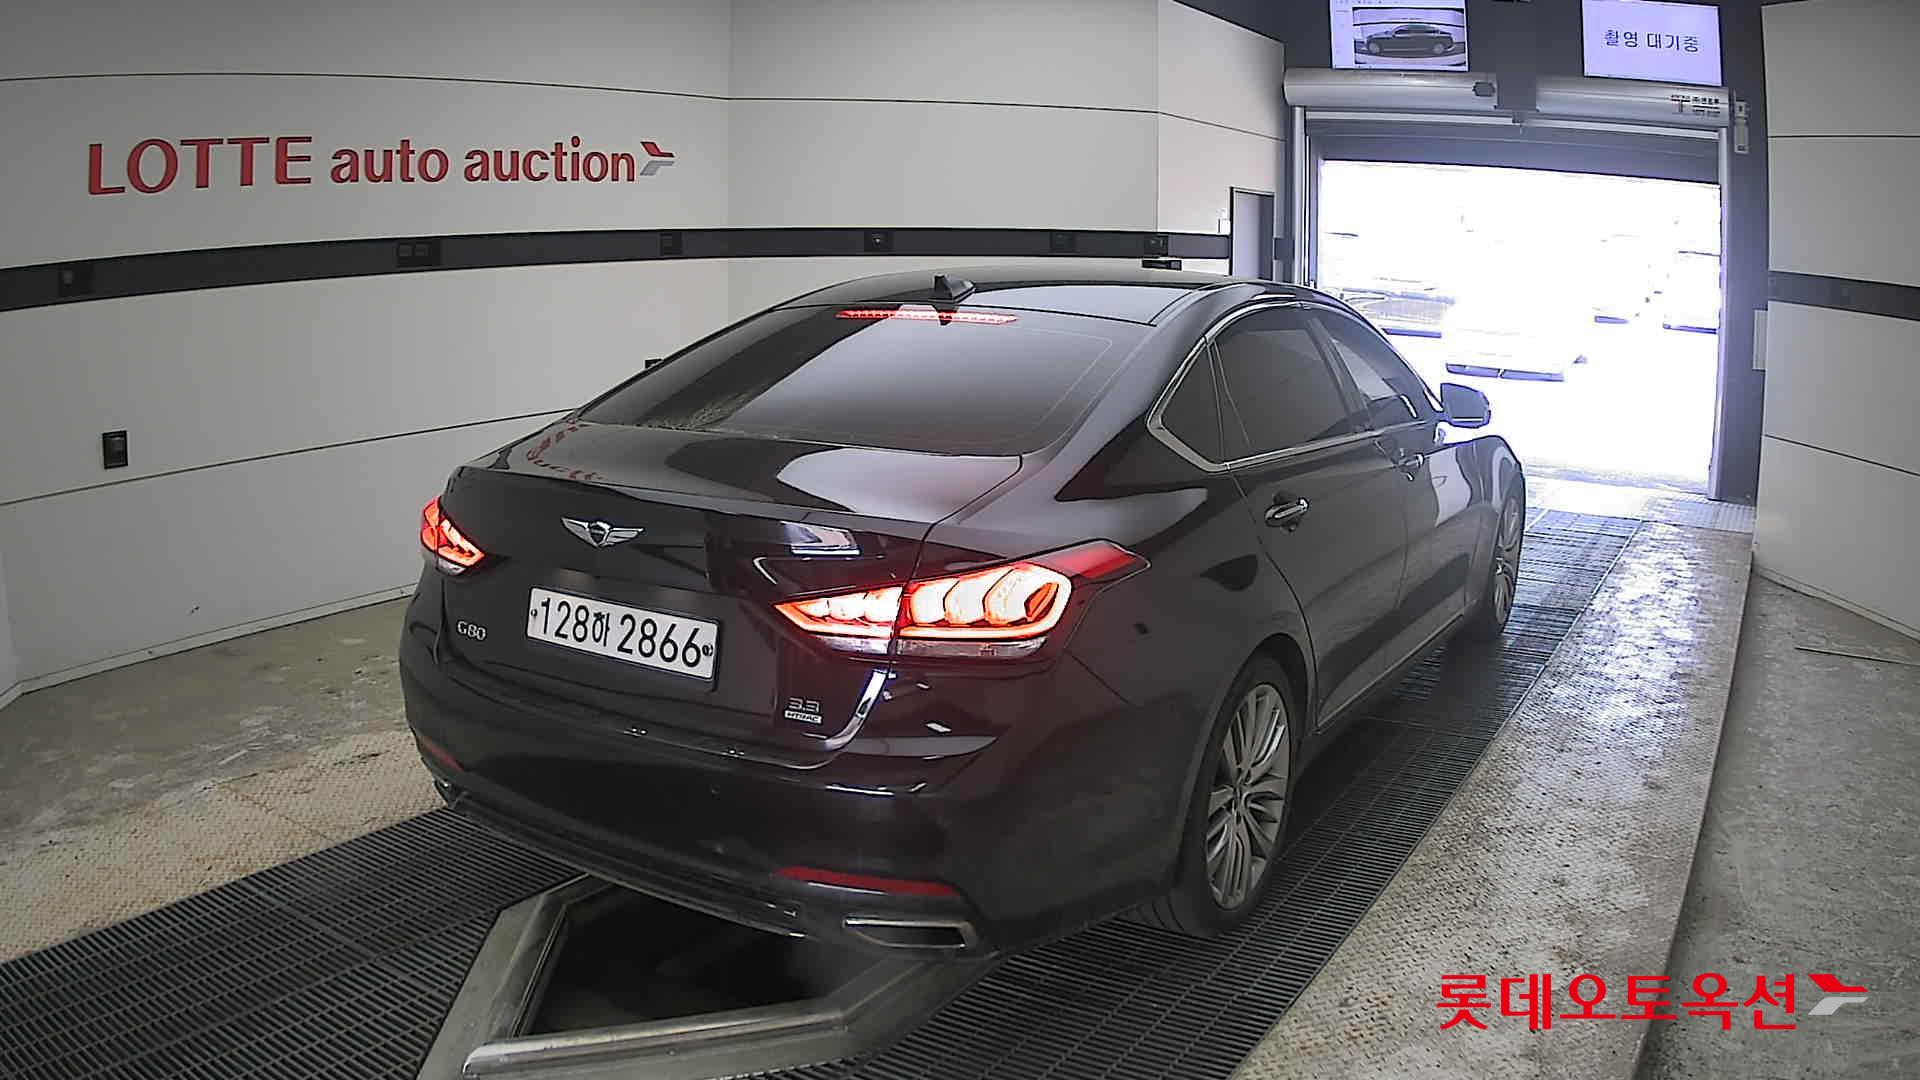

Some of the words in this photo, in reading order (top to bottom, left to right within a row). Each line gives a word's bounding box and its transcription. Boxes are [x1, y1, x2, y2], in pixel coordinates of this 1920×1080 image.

[1646, 33, 1699, 53] 대기중
[88, 136, 311, 195] LOTTE
[331, 138, 452, 184] auto
[464, 136, 637, 184] auction
[457, 620, 487, 641] G80
[541, 597, 611, 647] 128하
[616, 613, 702, 668] 2866
[788, 696, 820, 713] 3.3
